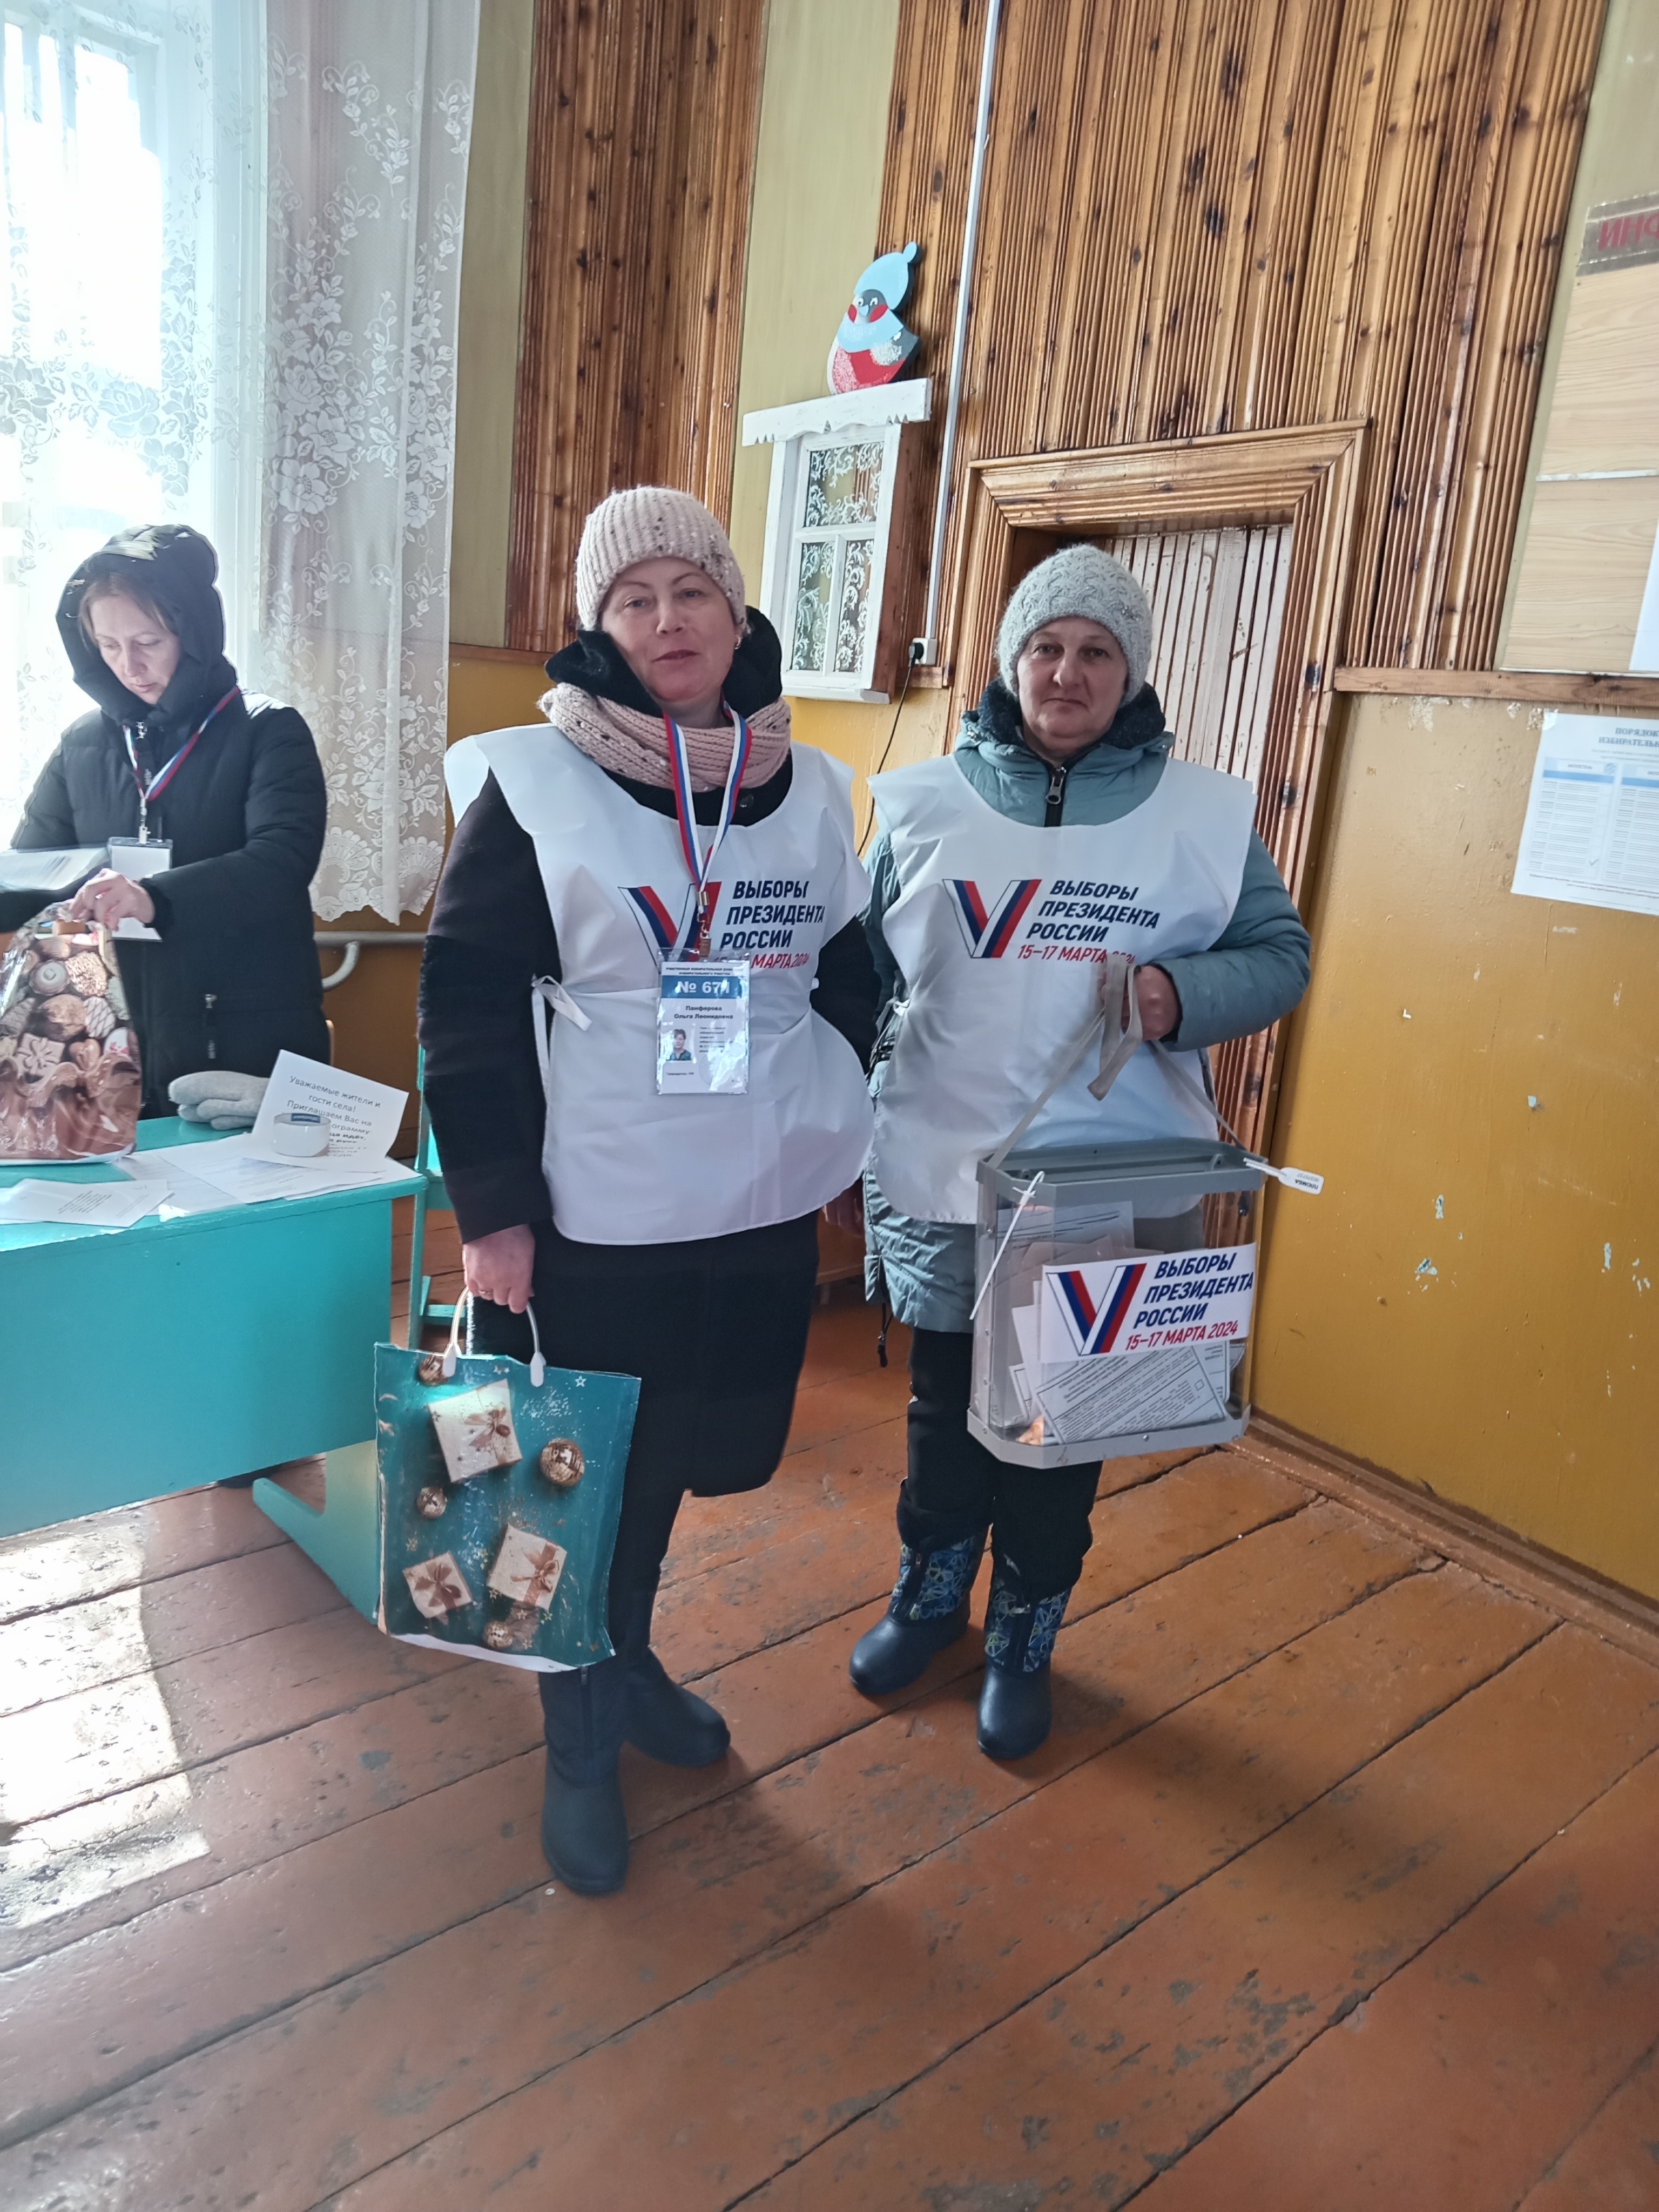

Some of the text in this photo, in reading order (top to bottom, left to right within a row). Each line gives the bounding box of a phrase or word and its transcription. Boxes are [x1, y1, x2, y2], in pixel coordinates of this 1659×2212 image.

[732, 880, 810, 899] ВЫБОРЫ
[1049, 880, 1139, 901] ВЫБОРЫ
[726, 905, 825, 925] ПРЕЗИДЕНТА
[1037, 900, 1161, 929] ПРЕЗИДЕНТА
[719, 929, 793, 952] РОССИИ
[1026, 922, 1109, 942] РОССИИ
[751, 953, 792, 969] МАРТА
[1057, 946, 1108, 963] МАРТА
[676, 981, 697, 994] №
[289, 1076, 340, 1096] Уважаемые
[341, 1092, 373, 1106] жители
[287, 1100, 342, 1120] Приглашаем
[345, 1115, 359, 1124] Вас
[308, 1095, 356, 1112] гости села!
[1154, 1252, 1237, 1279] ВЫБОРЫ
[1143, 1272, 1254, 1304] ПРЕЗИДЕНТА
[1133, 1303, 1209, 1329] РОССИИ
[1162, 1325, 1207, 1346] МАРТА
[1207, 1320, 1238, 1339] 2024
